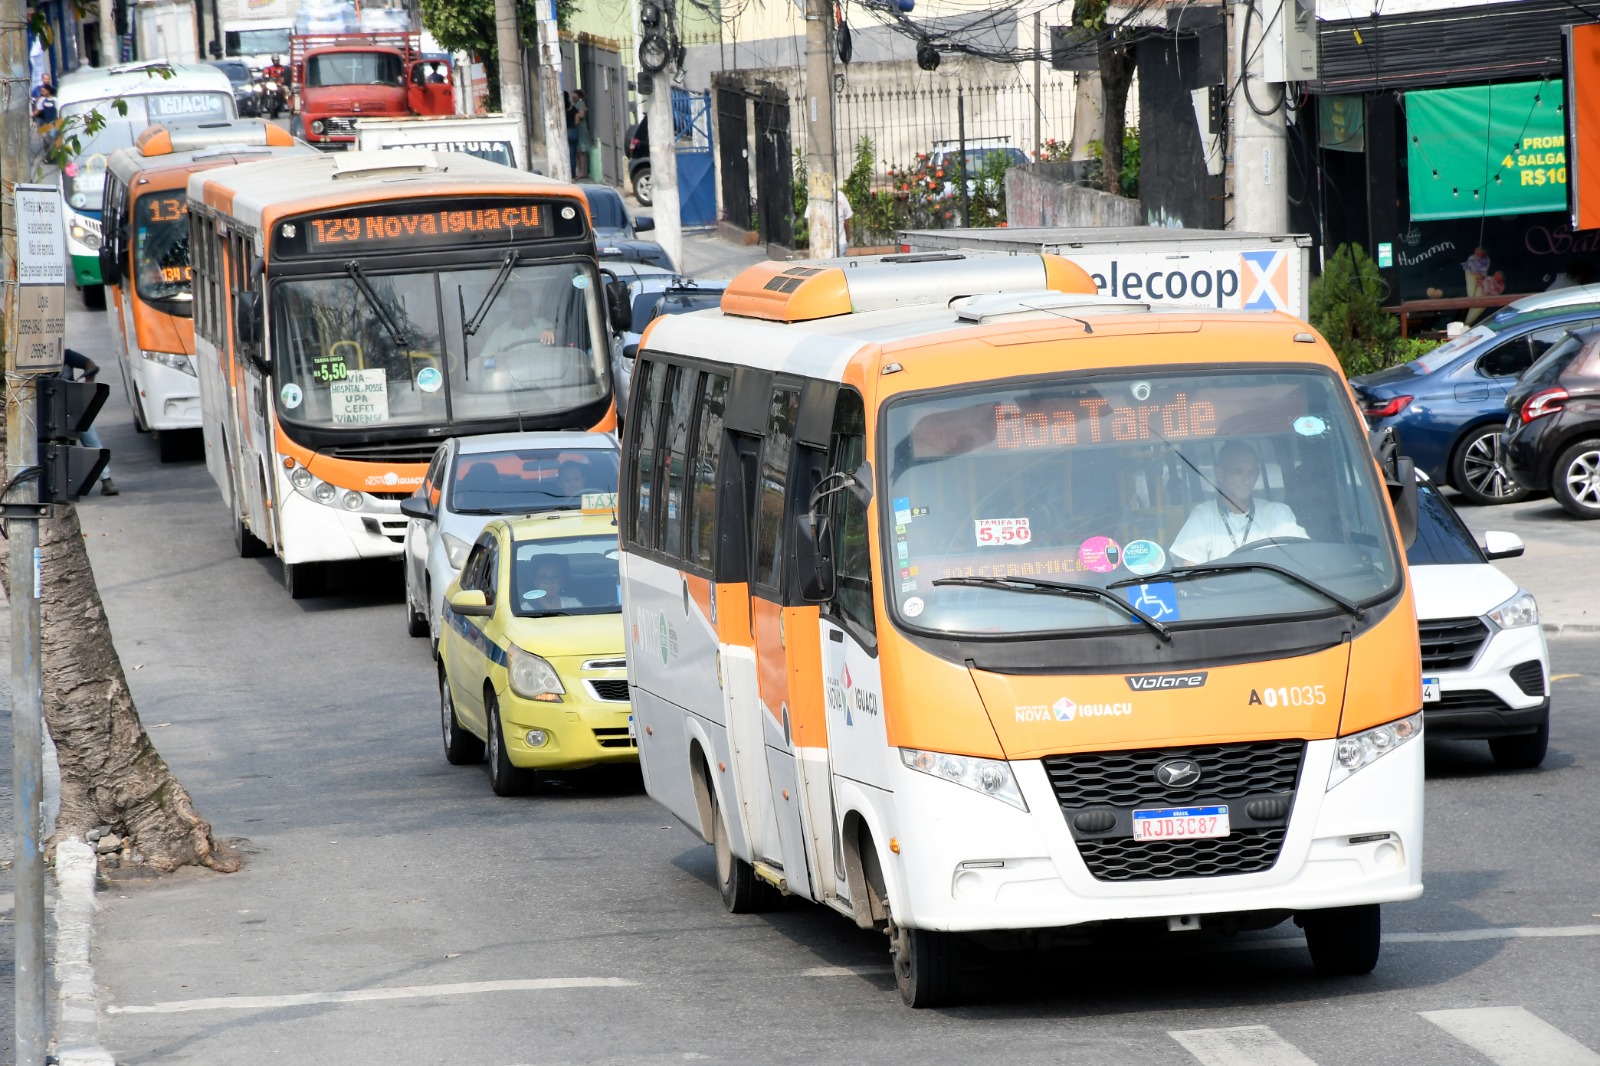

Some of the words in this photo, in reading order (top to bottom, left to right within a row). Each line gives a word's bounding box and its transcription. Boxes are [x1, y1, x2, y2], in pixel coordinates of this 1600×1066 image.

[1501, 154, 1515, 168] 4
[1517, 153, 1566, 167] SALGA
[311, 218, 360, 243] 129
[365, 213, 438, 240] Nova
[321, 362, 347, 381] 5,50
[345, 395, 368, 403] UPA
[979, 526, 1030, 544] 5,50
[1130, 674, 1203, 689] Volare
[1015, 710, 1051, 723] NOVA
[1079, 702, 1132, 718] IGUAÇU
[1142, 816, 1217, 837] RJD3C87
